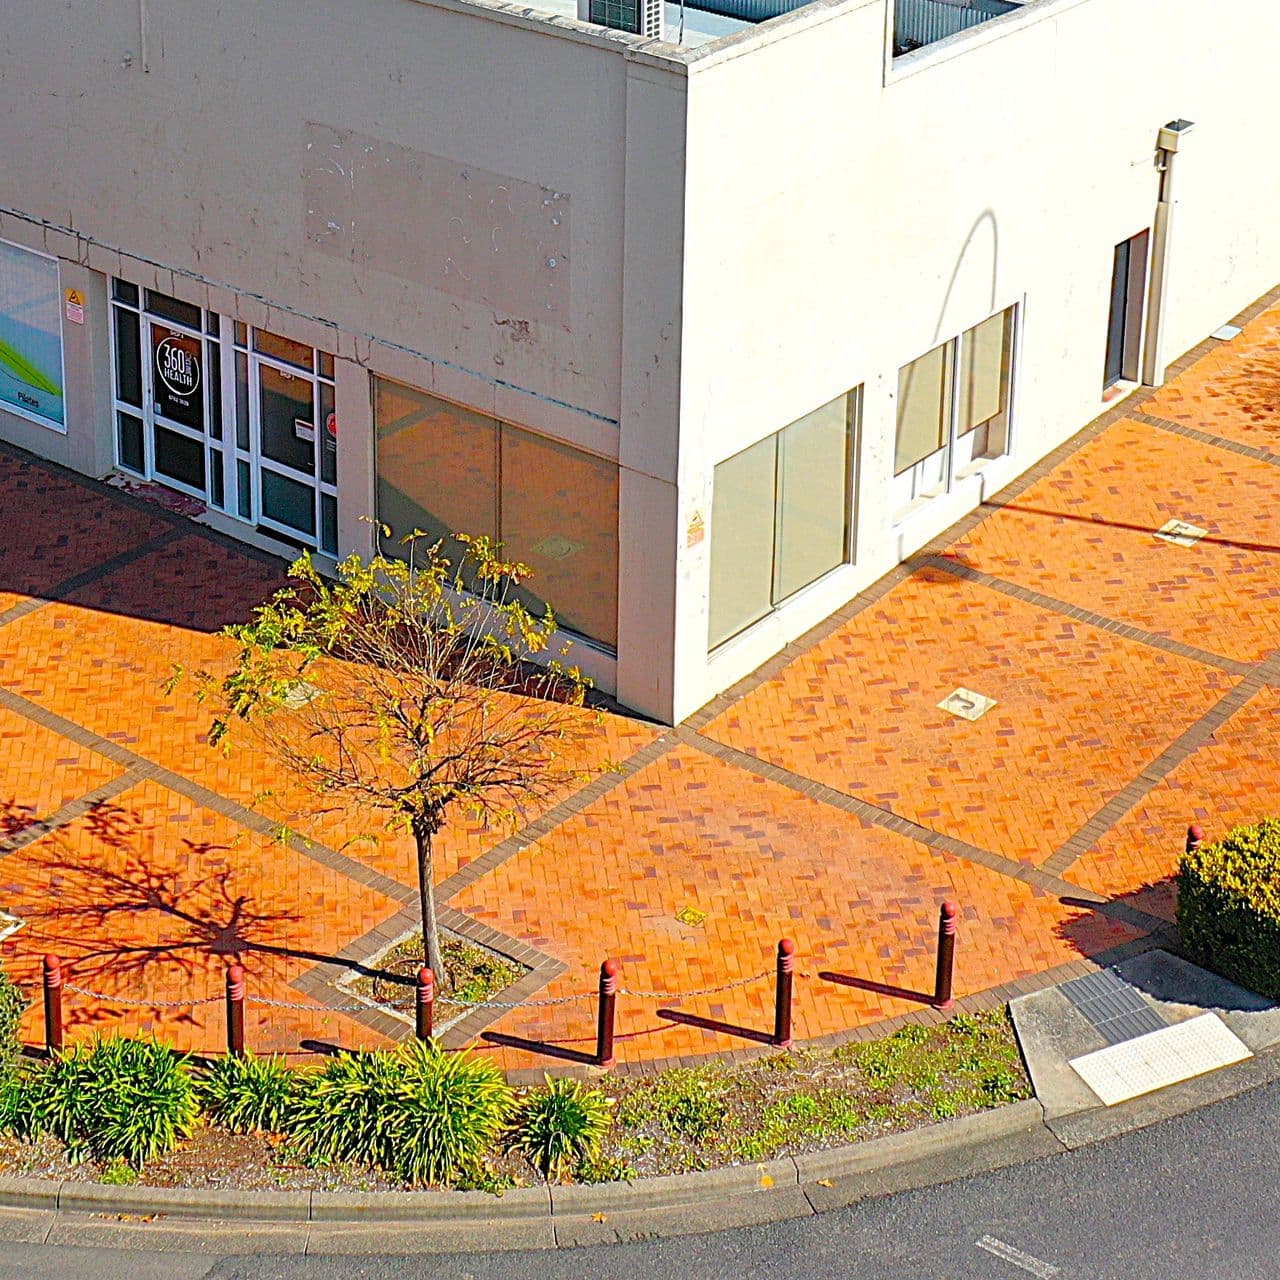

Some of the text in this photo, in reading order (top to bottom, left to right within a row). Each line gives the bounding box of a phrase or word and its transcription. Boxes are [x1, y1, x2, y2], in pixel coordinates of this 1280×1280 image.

[163, 343, 185, 373] 360
[164, 367, 192, 387] HEALTH
[18, 391, 39, 408] Pilates
